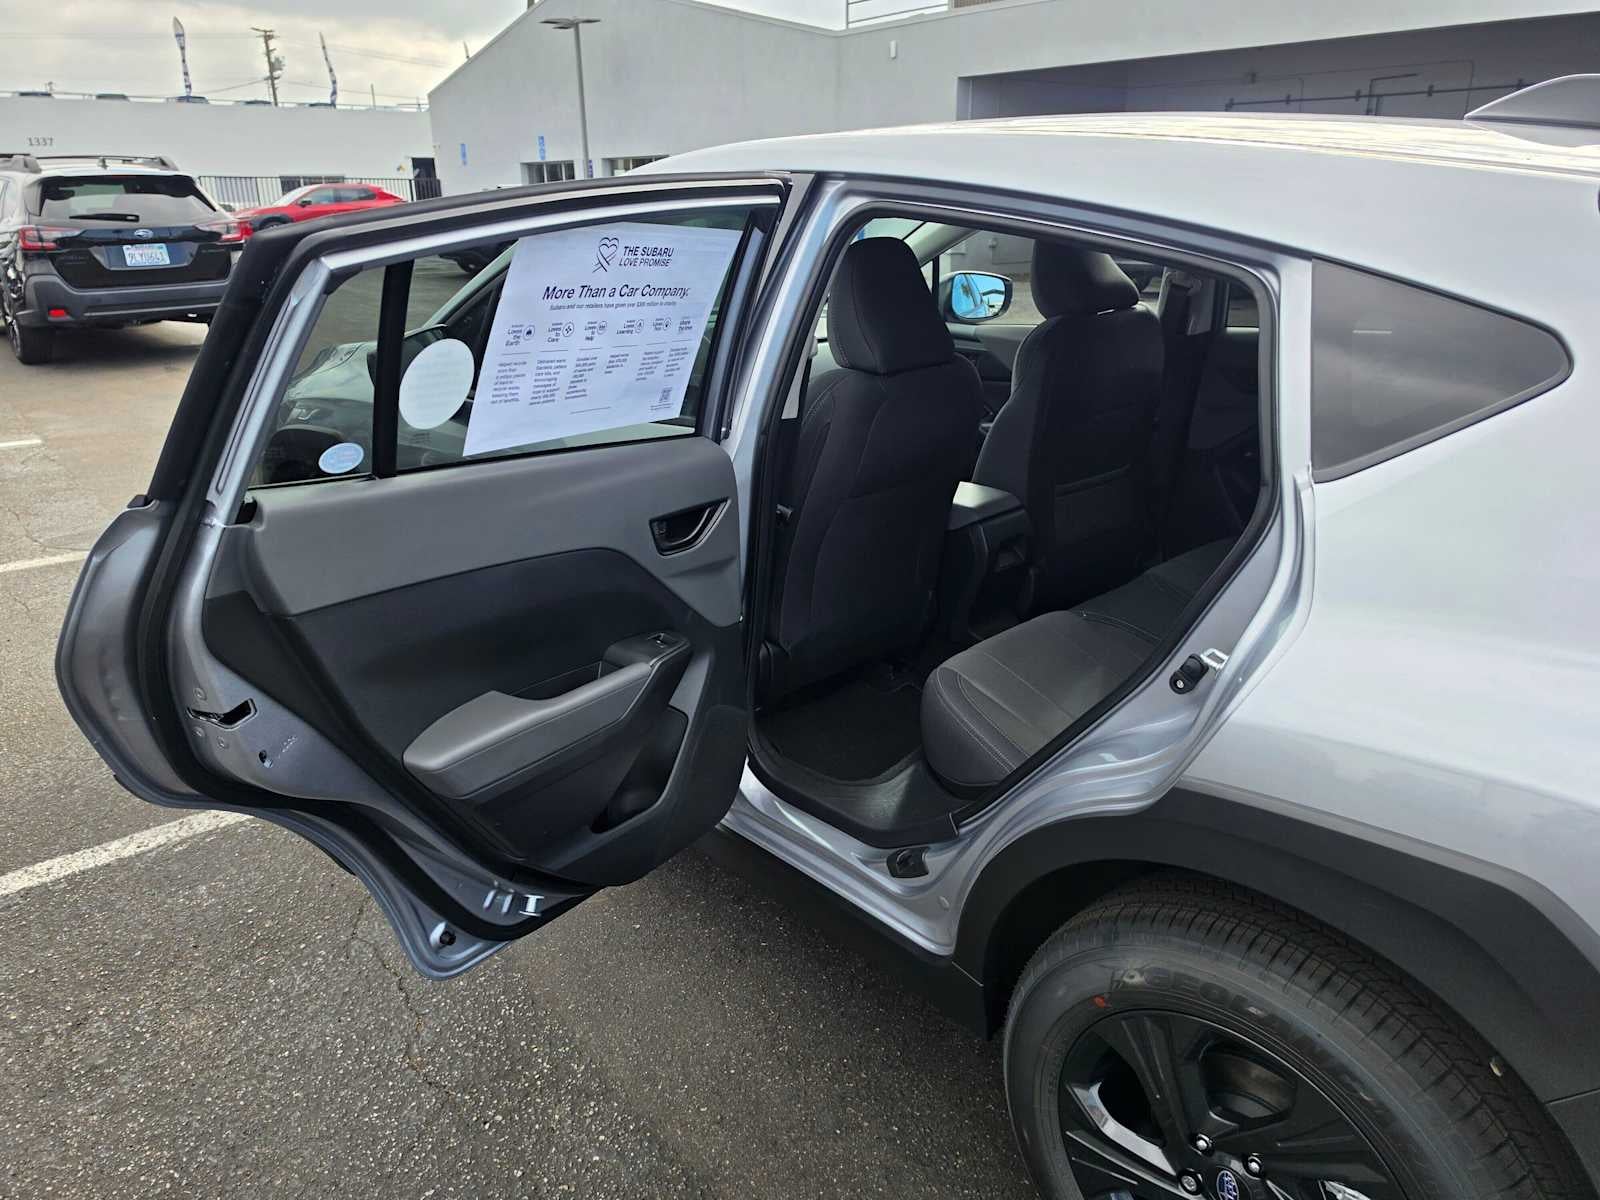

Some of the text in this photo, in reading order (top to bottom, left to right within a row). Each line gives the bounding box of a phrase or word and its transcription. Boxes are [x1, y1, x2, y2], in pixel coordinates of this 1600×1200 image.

[27, 136, 54, 147] 1337
[623, 245, 675, 258] THE SUBARU
[618, 257, 670, 267] LOVE PROMISE
[542, 284, 690, 300] More Than a Car Company.
